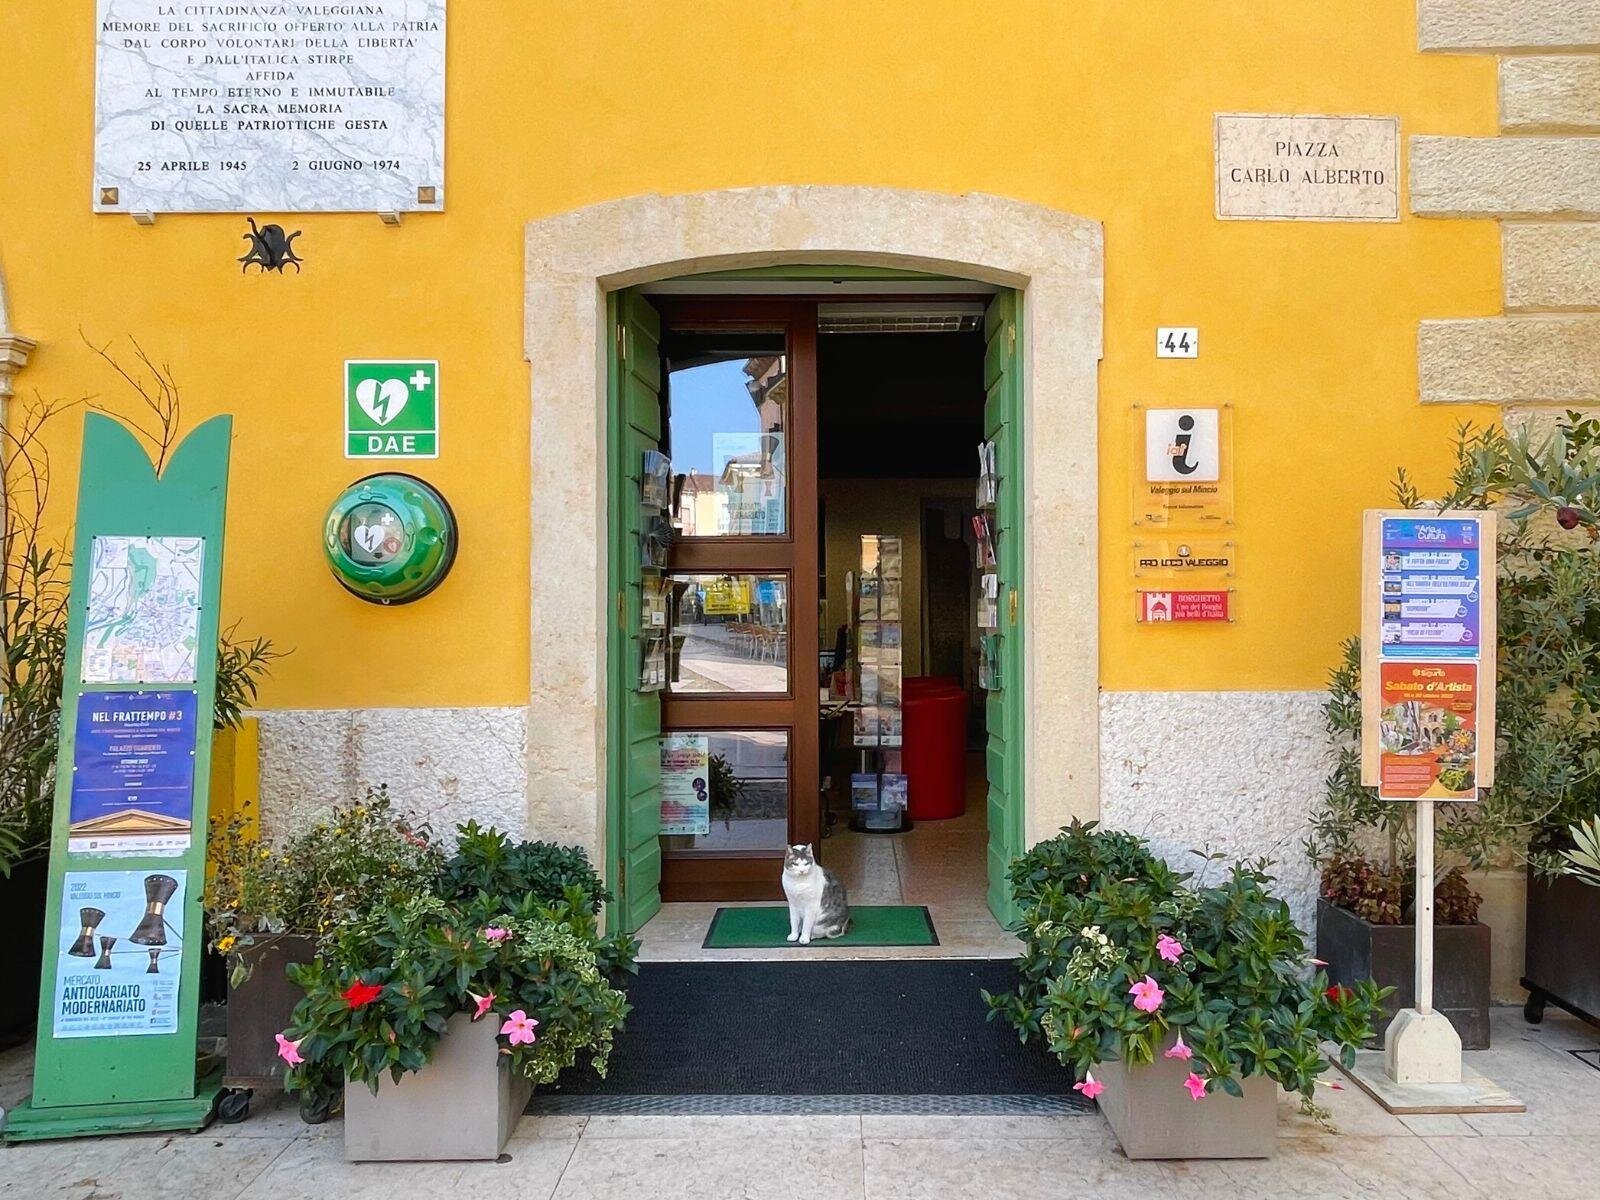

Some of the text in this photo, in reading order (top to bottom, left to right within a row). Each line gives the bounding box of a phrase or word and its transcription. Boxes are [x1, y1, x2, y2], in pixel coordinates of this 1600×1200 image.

[158, 6, 384, 16] LA CITTADINANZA VALEGGIANA
[102, 22, 438, 32] MEMORE DEL SACRIFICIO OFFERTO ALLA PATRIA
[124, 38, 151, 48] DAL
[160, 38, 206, 48] CORPO
[216, 38, 294, 48] VOLONTARI
[305, 38, 348, 48] DELLA
[187, 55, 354, 65] E DALL'ITALICA STIRPE
[246, 71, 295, 81] AFFIDA
[144, 87, 396, 98] AL TEMPO ETERNO E IMMUTABILE
[196, 104, 343, 114] LA SACRA MEMORIA
[150, 120, 388, 131] DI QUELLE PATRIOTTICHE GESTA
[1275, 142, 1339, 157] PIAZZA
[137, 160, 247, 171] 25 APRILE 1945
[292, 160, 400, 171] 2 GIUGNO 1974
[1231, 168, 1384, 185] CARLO ALBERTO
[368, 435, 416, 453] DAE
[1150, 485, 1218, 495] Valeggio sul Mincio
[1140, 558, 1228, 567] PRO LOCO VALEGGIO
[1178, 594, 1221, 602] BORGHETTO
[1385, 681, 1473, 692] Sabato d'Artista
[92, 711, 183, 722] NEL FRATTEMPO #3
[63, 974, 101, 986] MERCATO
[63, 984, 140, 1001] ANTIQUARIATO
[62, 998, 146, 1016] MODERNARIATO
